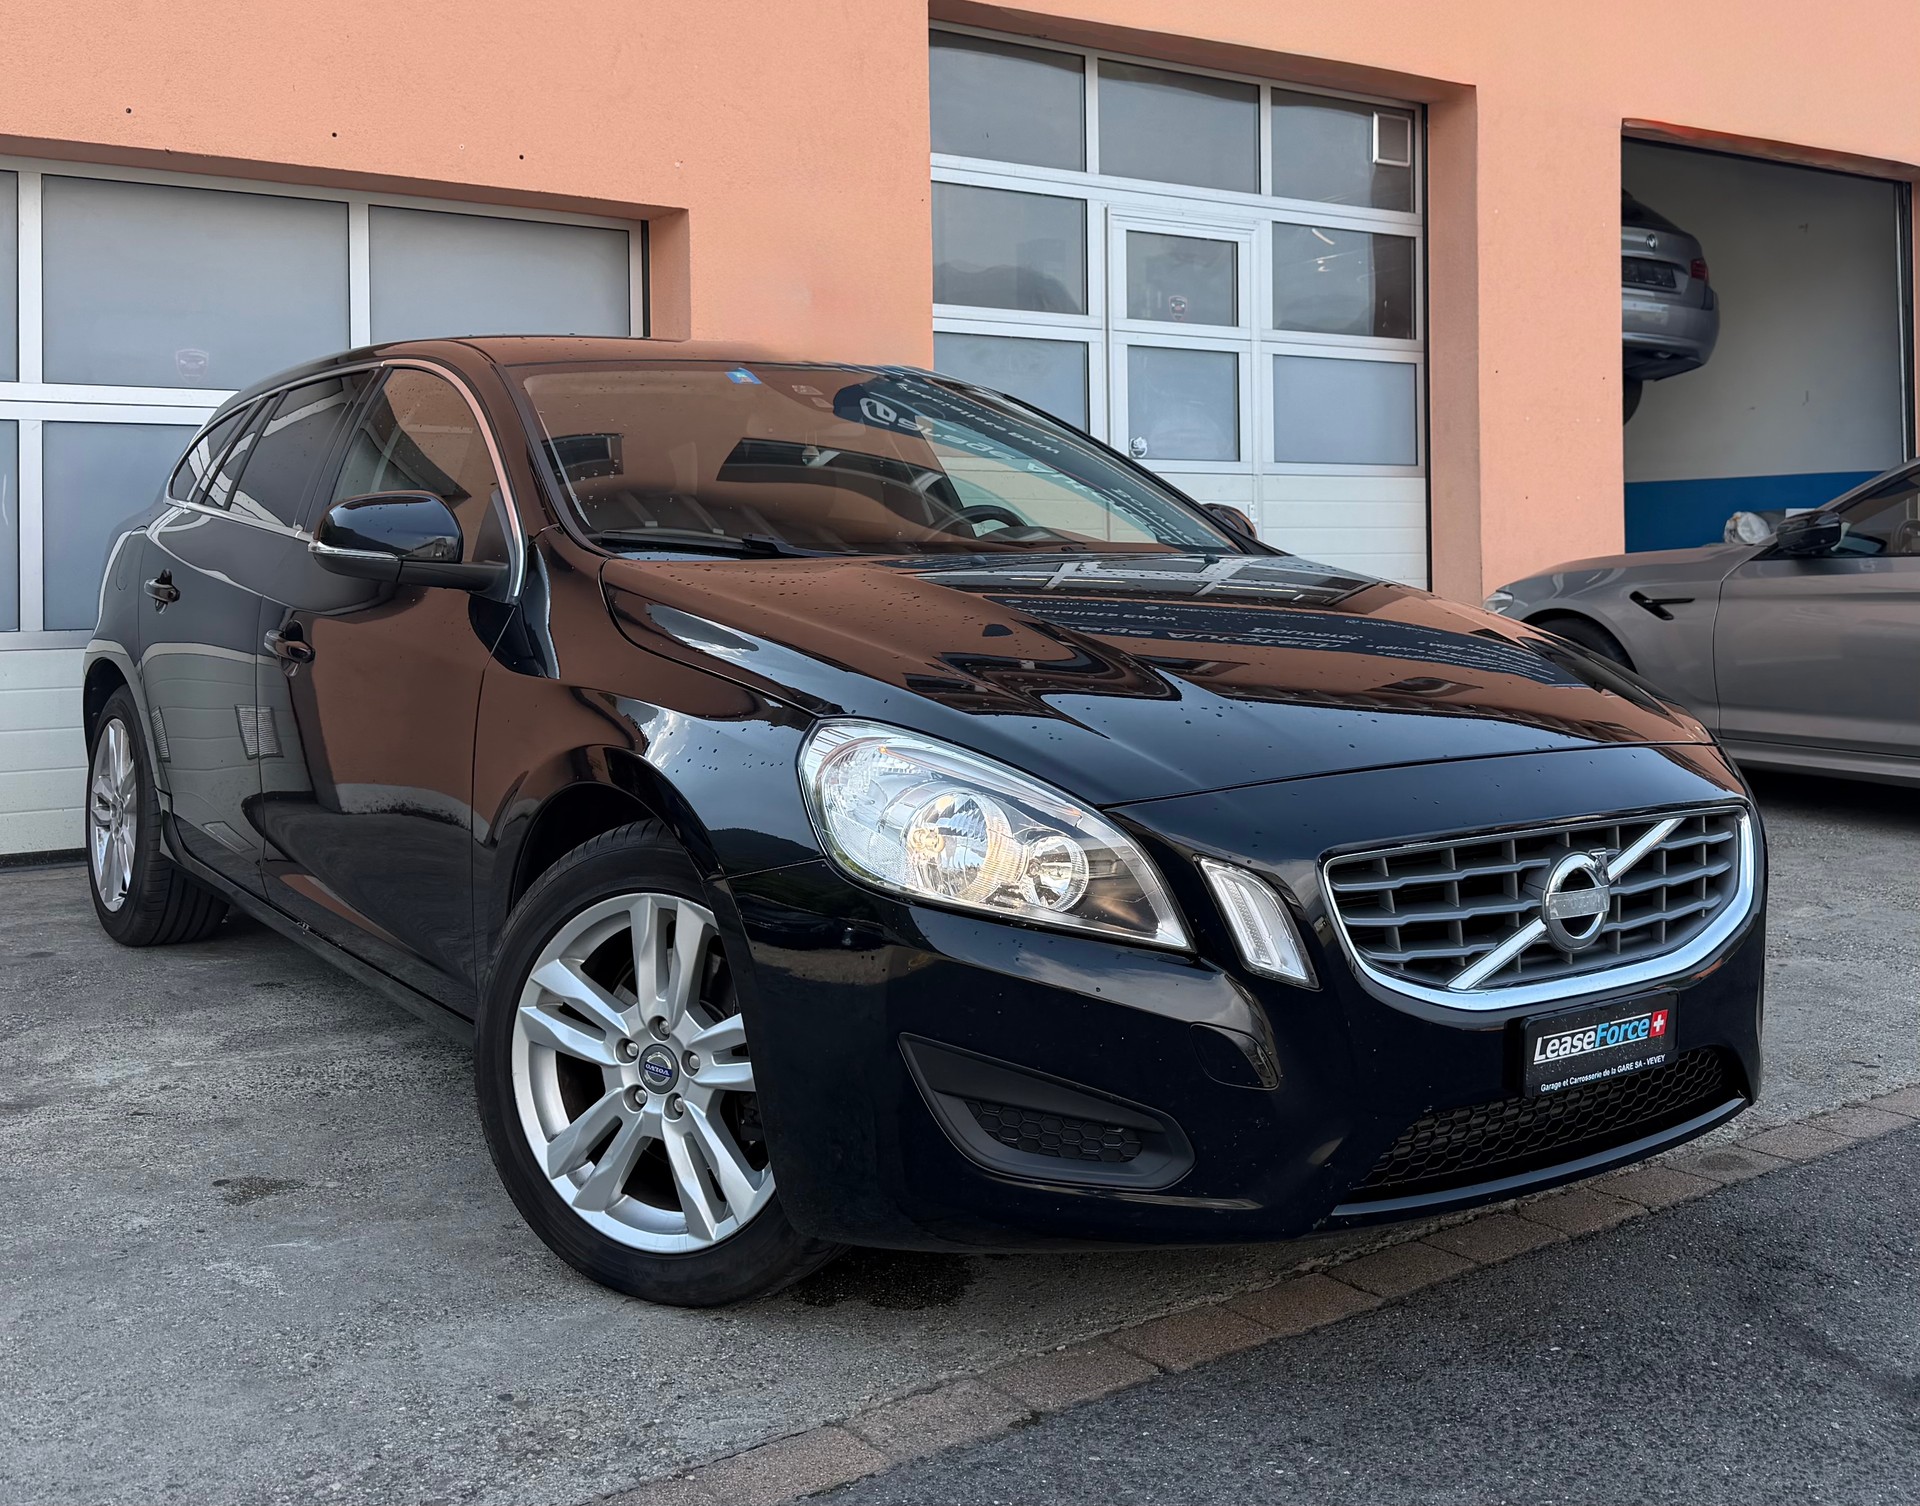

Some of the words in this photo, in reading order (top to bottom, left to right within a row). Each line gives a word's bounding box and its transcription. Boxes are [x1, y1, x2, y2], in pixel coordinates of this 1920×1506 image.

[1533, 1018, 1650, 1062] LeaseForce
[645, 1063, 670, 1076] VOLVO
[1541, 1081, 1561, 1092] Garage
[1562, 1079, 1569, 1087] et
[1569, 1071, 1602, 1085] Carrosserie
[1603, 1069, 1610, 1077] de
[1617, 1062, 1634, 1073] GARE
[1634, 1060, 1642, 1069] SA
[1646, 1054, 1666, 1066] VEVEY
